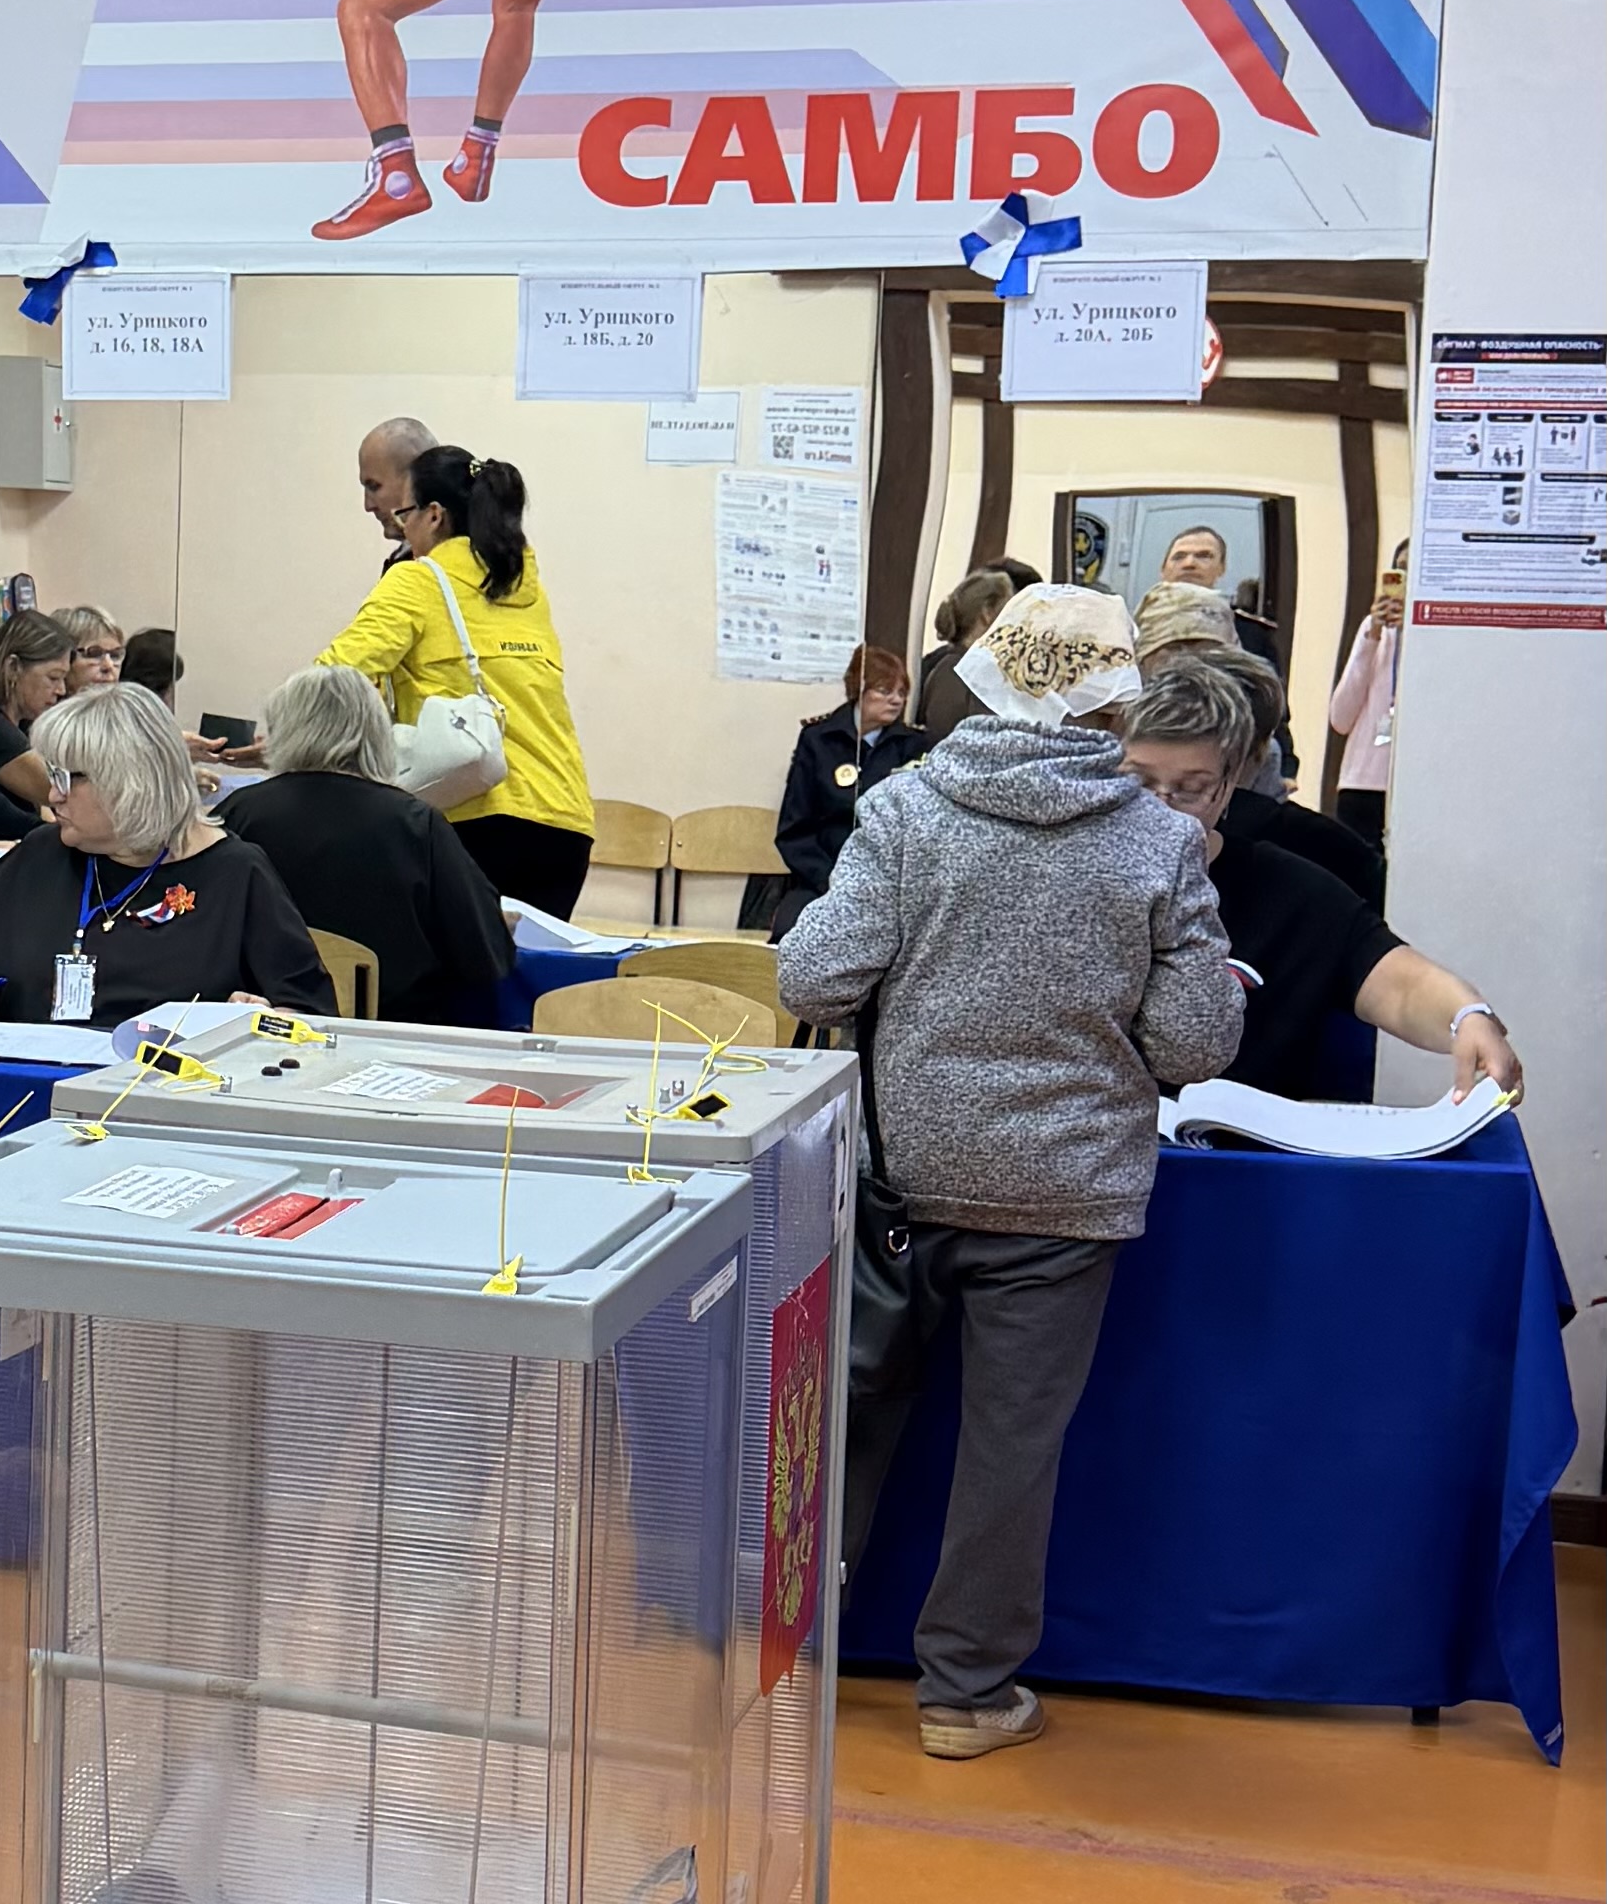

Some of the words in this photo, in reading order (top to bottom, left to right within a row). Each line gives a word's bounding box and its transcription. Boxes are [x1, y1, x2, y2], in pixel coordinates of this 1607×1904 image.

[578, 84, 1220, 207] САМБО
[87, 316, 113, 333] ул.
[119, 313, 208, 332] Урицкого
[544, 311, 572, 328] ул.
[578, 308, 675, 329] Урицкого
[1033, 306, 1064, 324] ул.
[1072, 302, 1177, 324] Урицкого
[563, 334, 576, 346] д.
[617, 335, 631, 346] д.
[636, 332, 654, 346] 20
[1054, 332, 1069, 343] д.
[1121, 327, 1153, 342] 20Б
[89, 342, 105, 354] д.
[112, 337, 136, 355] 16,
[142, 337, 166, 355] 18,
[172, 337, 204, 353] 18А
